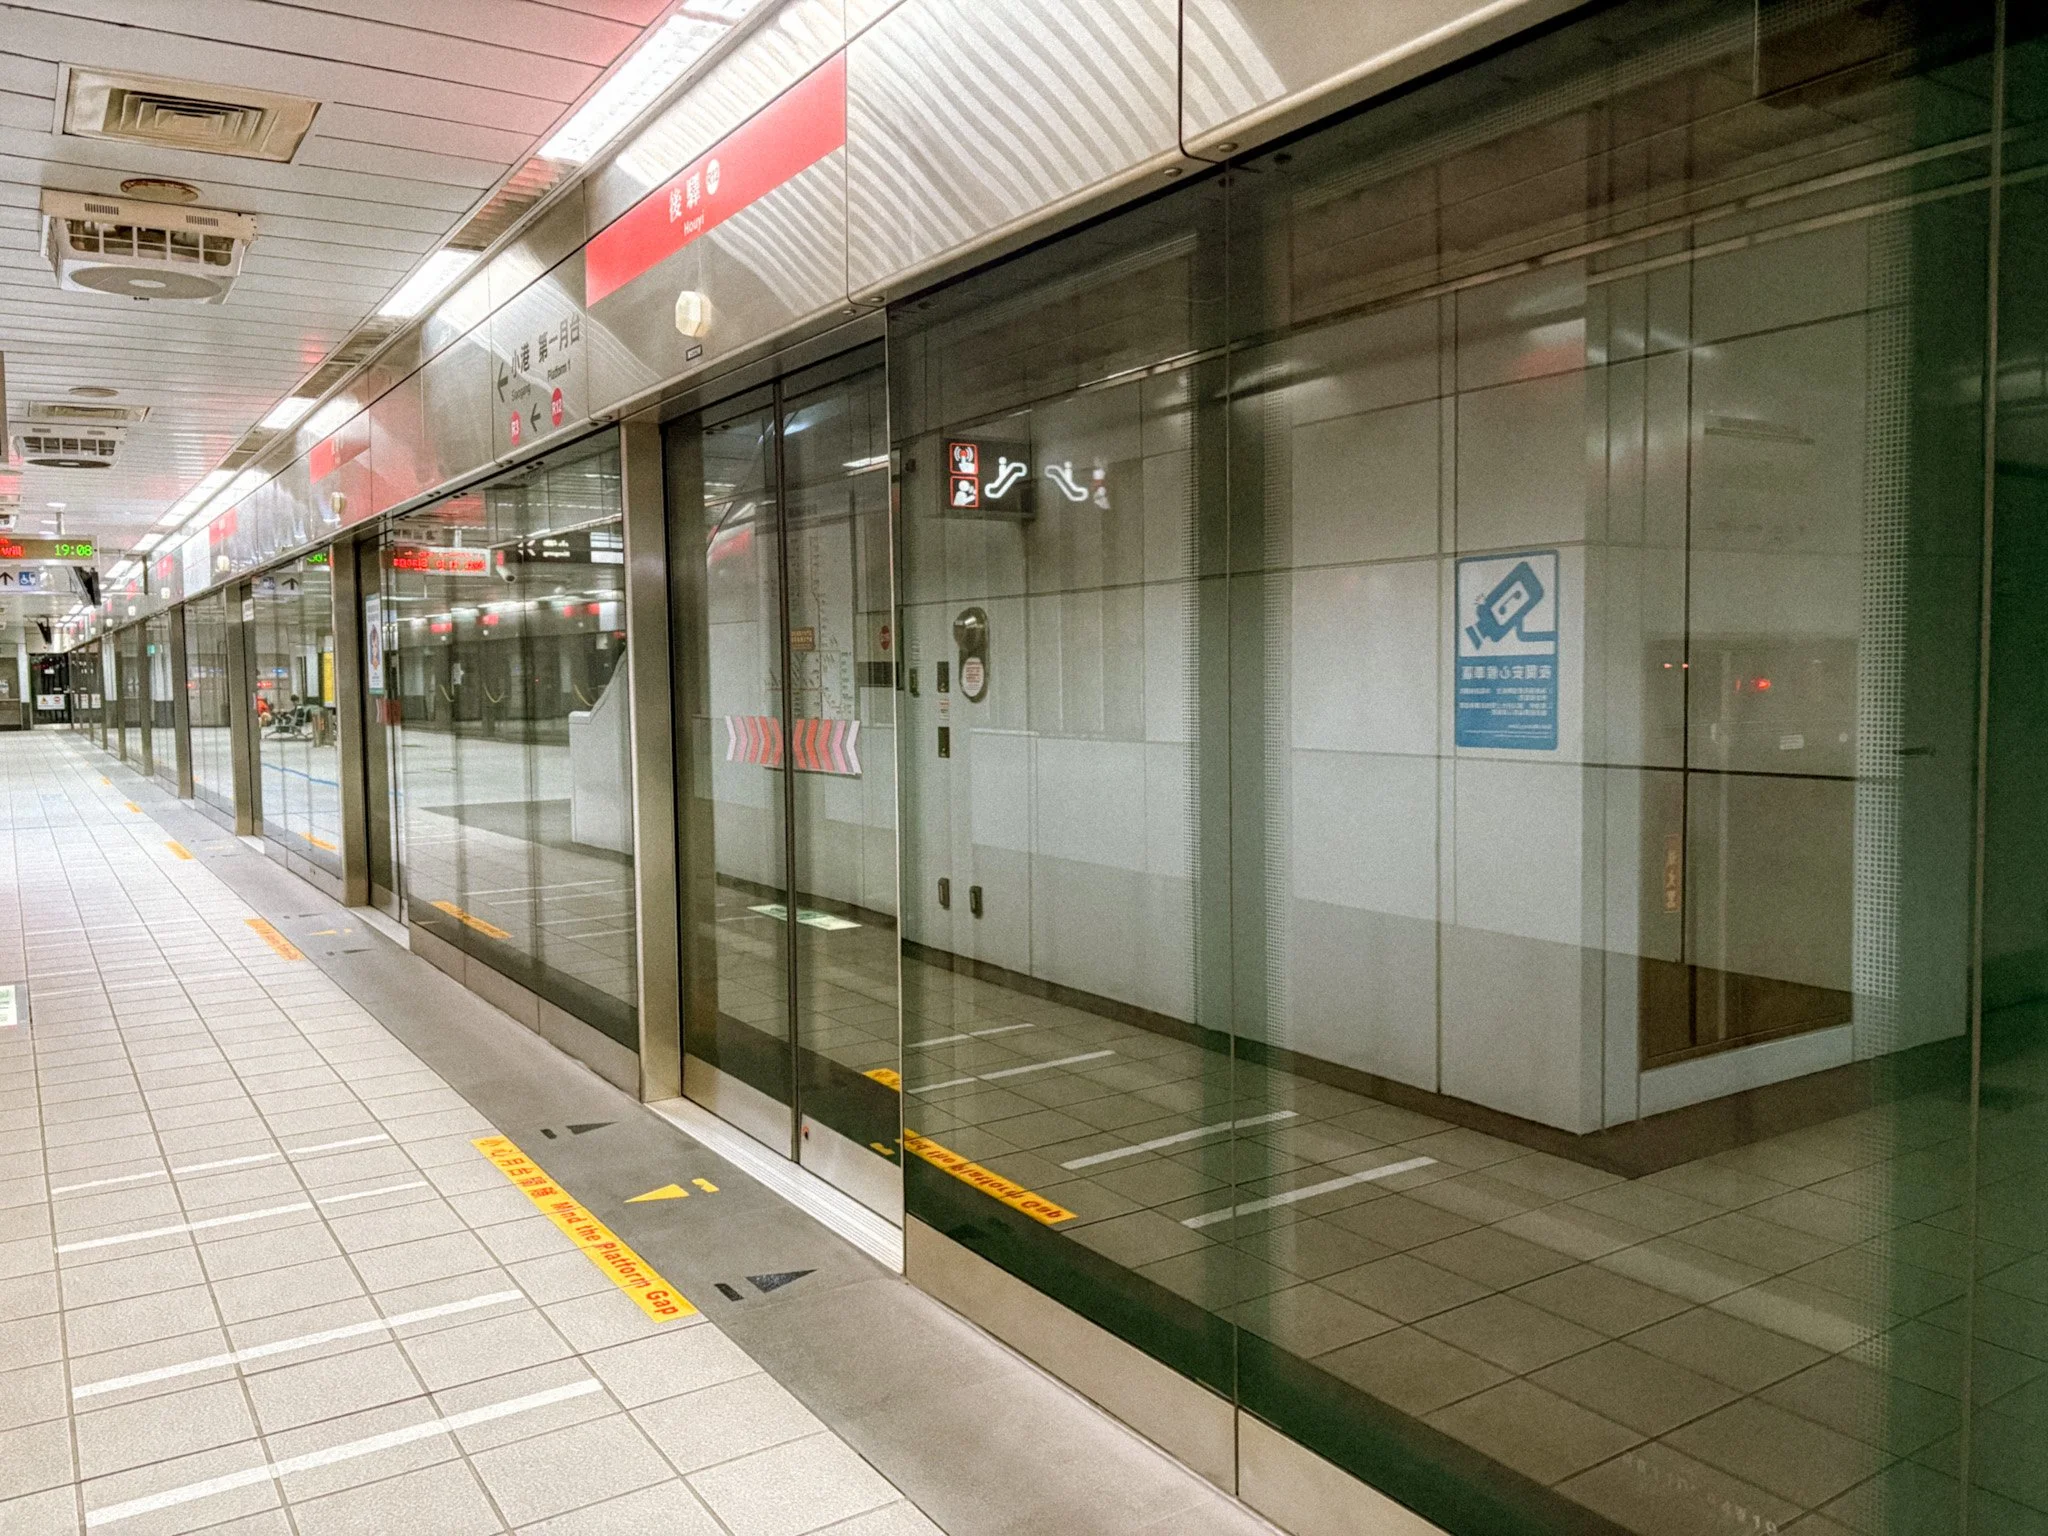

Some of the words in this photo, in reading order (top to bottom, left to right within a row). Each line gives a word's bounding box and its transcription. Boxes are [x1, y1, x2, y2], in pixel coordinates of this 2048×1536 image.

[683, 208, 704, 237] Houyi
[538, 312, 580, 364] 第一月台
[54, 544, 93, 557] 19:08
[550, 1201, 585, 1225] Mind
[575, 1225, 602, 1243] the
[595, 1241, 652, 1290] Platform
[645, 1289, 680, 1316] Gap
